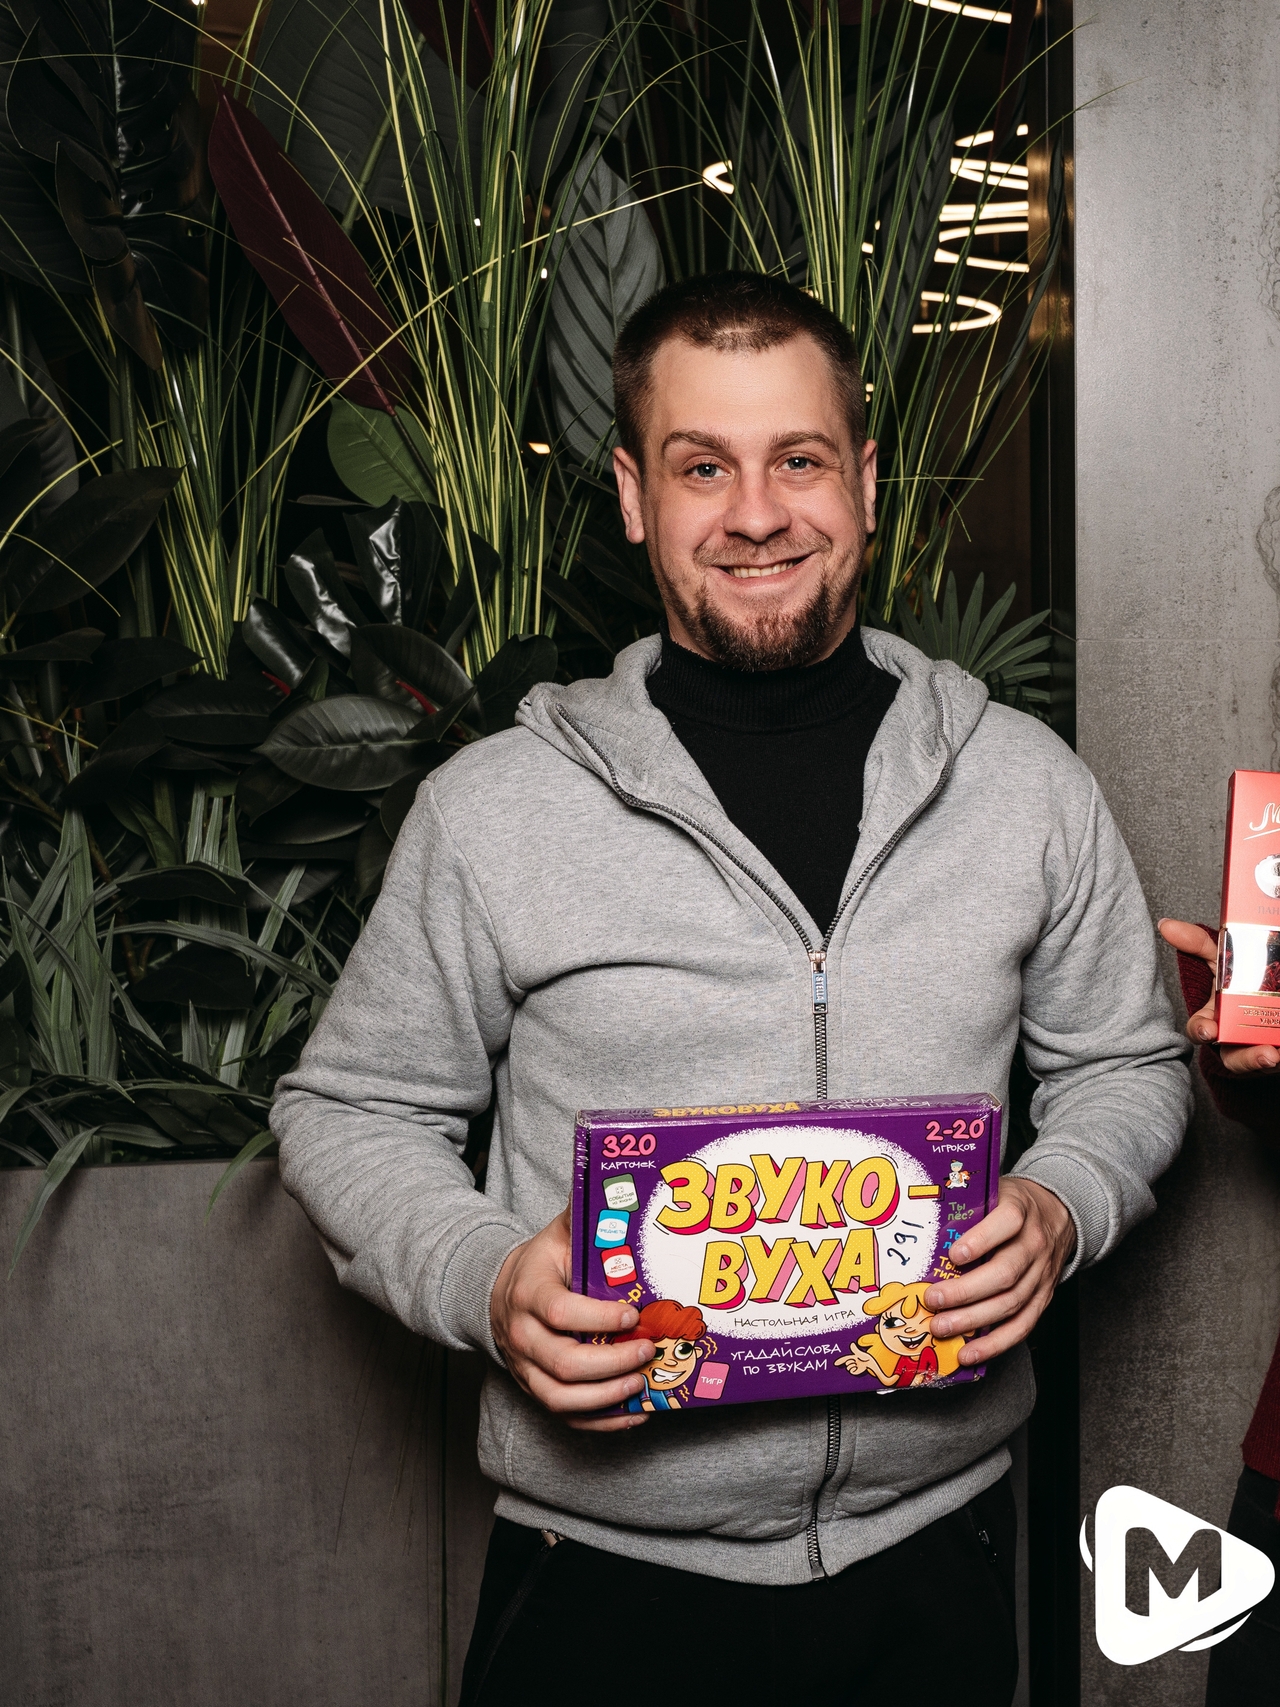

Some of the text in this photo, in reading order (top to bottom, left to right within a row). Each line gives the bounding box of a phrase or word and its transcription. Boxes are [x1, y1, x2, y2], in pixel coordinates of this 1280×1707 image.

[653, 1101, 800, 1117] ЗВУКОВУХА
[925, 1118, 986, 1142] 2-20
[602, 1133, 658, 1159] 320
[932, 1143, 976, 1153] ИГРОКОВ
[601, 1160, 657, 1171] КАРТОЧЕК
[656, 1153, 941, 1235] ЗВУКО-
[698, 1228, 880, 1309] ВУХА
[734, 1309, 855, 1327] НАСТОЛЬНАЯ ИГРА
[730, 1341, 841, 1361] УГАДАЙ СЛОВА
[743, 1359, 828, 1376] ПО ЗВУКАМ
[701, 1376, 723, 1386] ТИГР
